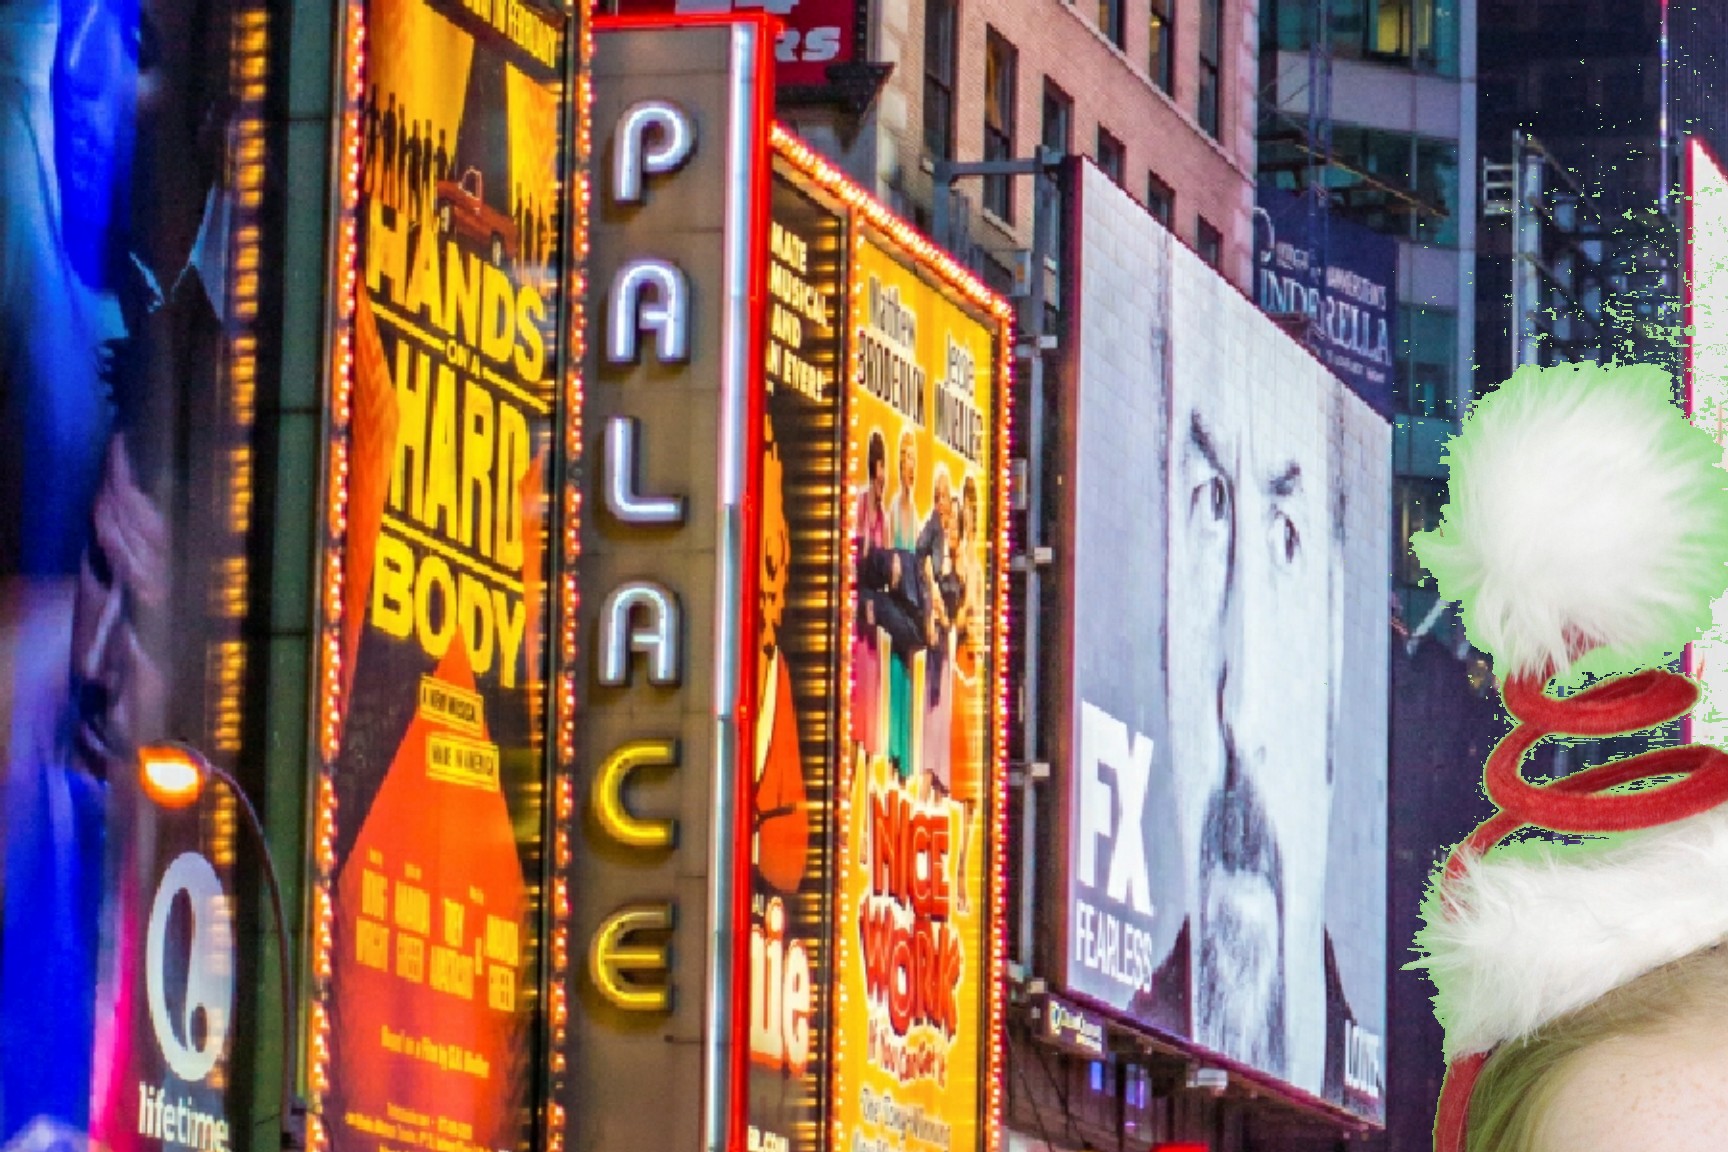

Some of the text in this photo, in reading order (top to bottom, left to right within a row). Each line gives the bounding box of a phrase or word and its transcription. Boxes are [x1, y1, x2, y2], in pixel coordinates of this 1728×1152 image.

[366, 196, 545, 383] HANDS
[772, 303, 801, 349] AND
[391, 339, 532, 570] HARD
[371, 530, 527, 688] BODY
[590, 100, 698, 1012] PALACE
[867, 789, 949, 922] NICE
[1081, 699, 1154, 916] FX
[859, 898, 960, 1042] WORK
[1075, 898, 1152, 994] FEARLESS
